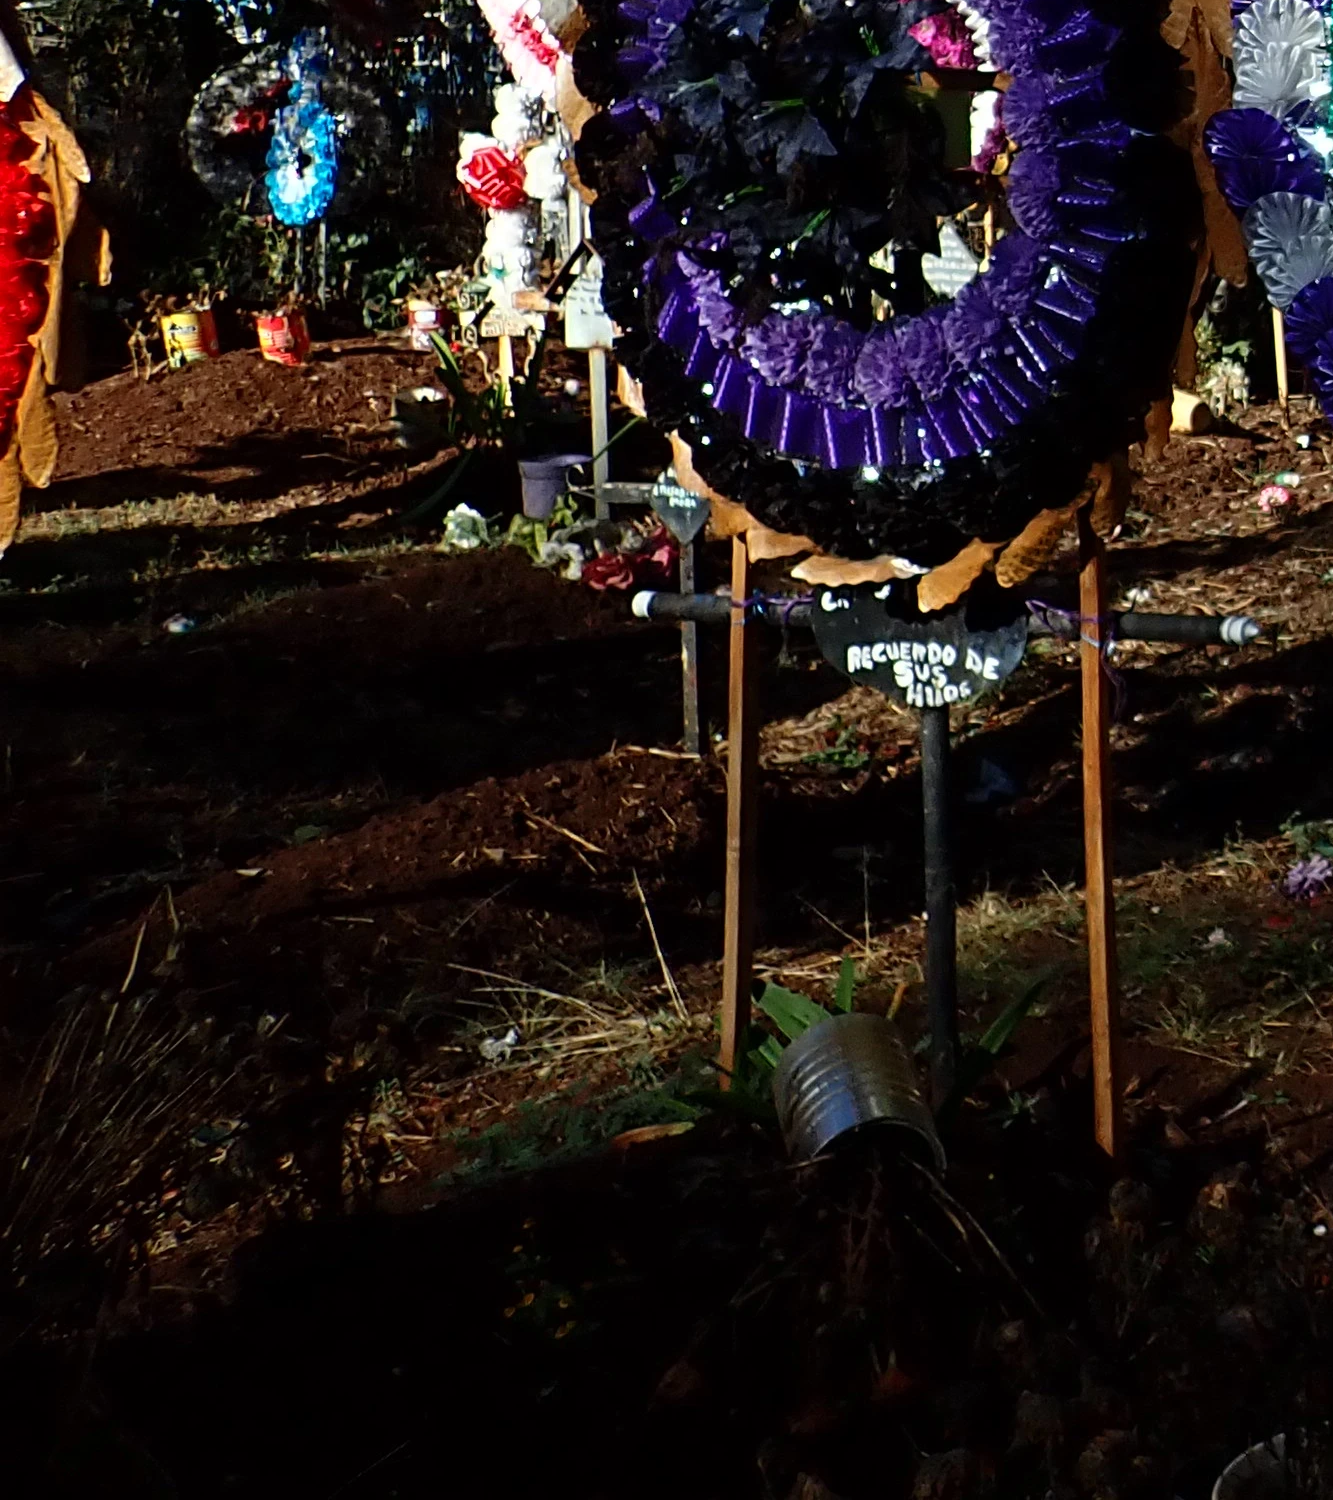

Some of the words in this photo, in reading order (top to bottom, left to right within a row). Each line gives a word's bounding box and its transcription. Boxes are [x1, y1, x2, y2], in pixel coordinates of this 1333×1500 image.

[847, 641, 957, 673] RECUERDO
[965, 647, 1000, 680] DE
[893, 660, 948, 688] SUS
